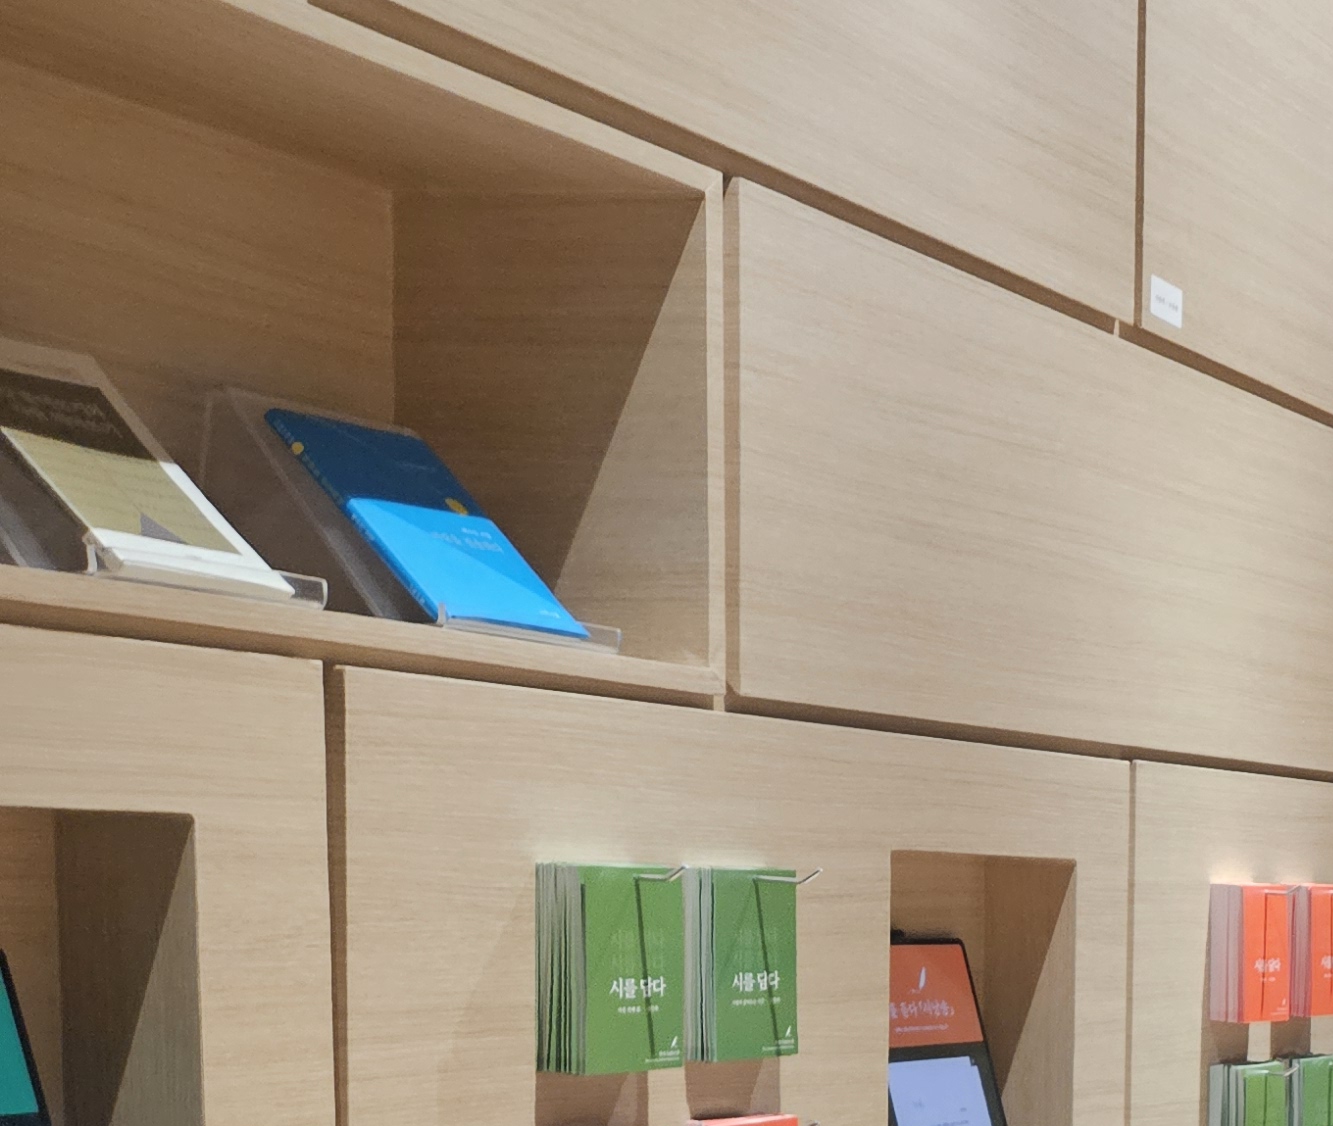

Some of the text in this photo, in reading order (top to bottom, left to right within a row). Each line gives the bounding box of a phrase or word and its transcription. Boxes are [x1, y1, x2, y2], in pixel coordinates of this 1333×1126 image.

[609, 975, 667, 999] 시를 담다
[732, 969, 781, 993] 시를 담다
